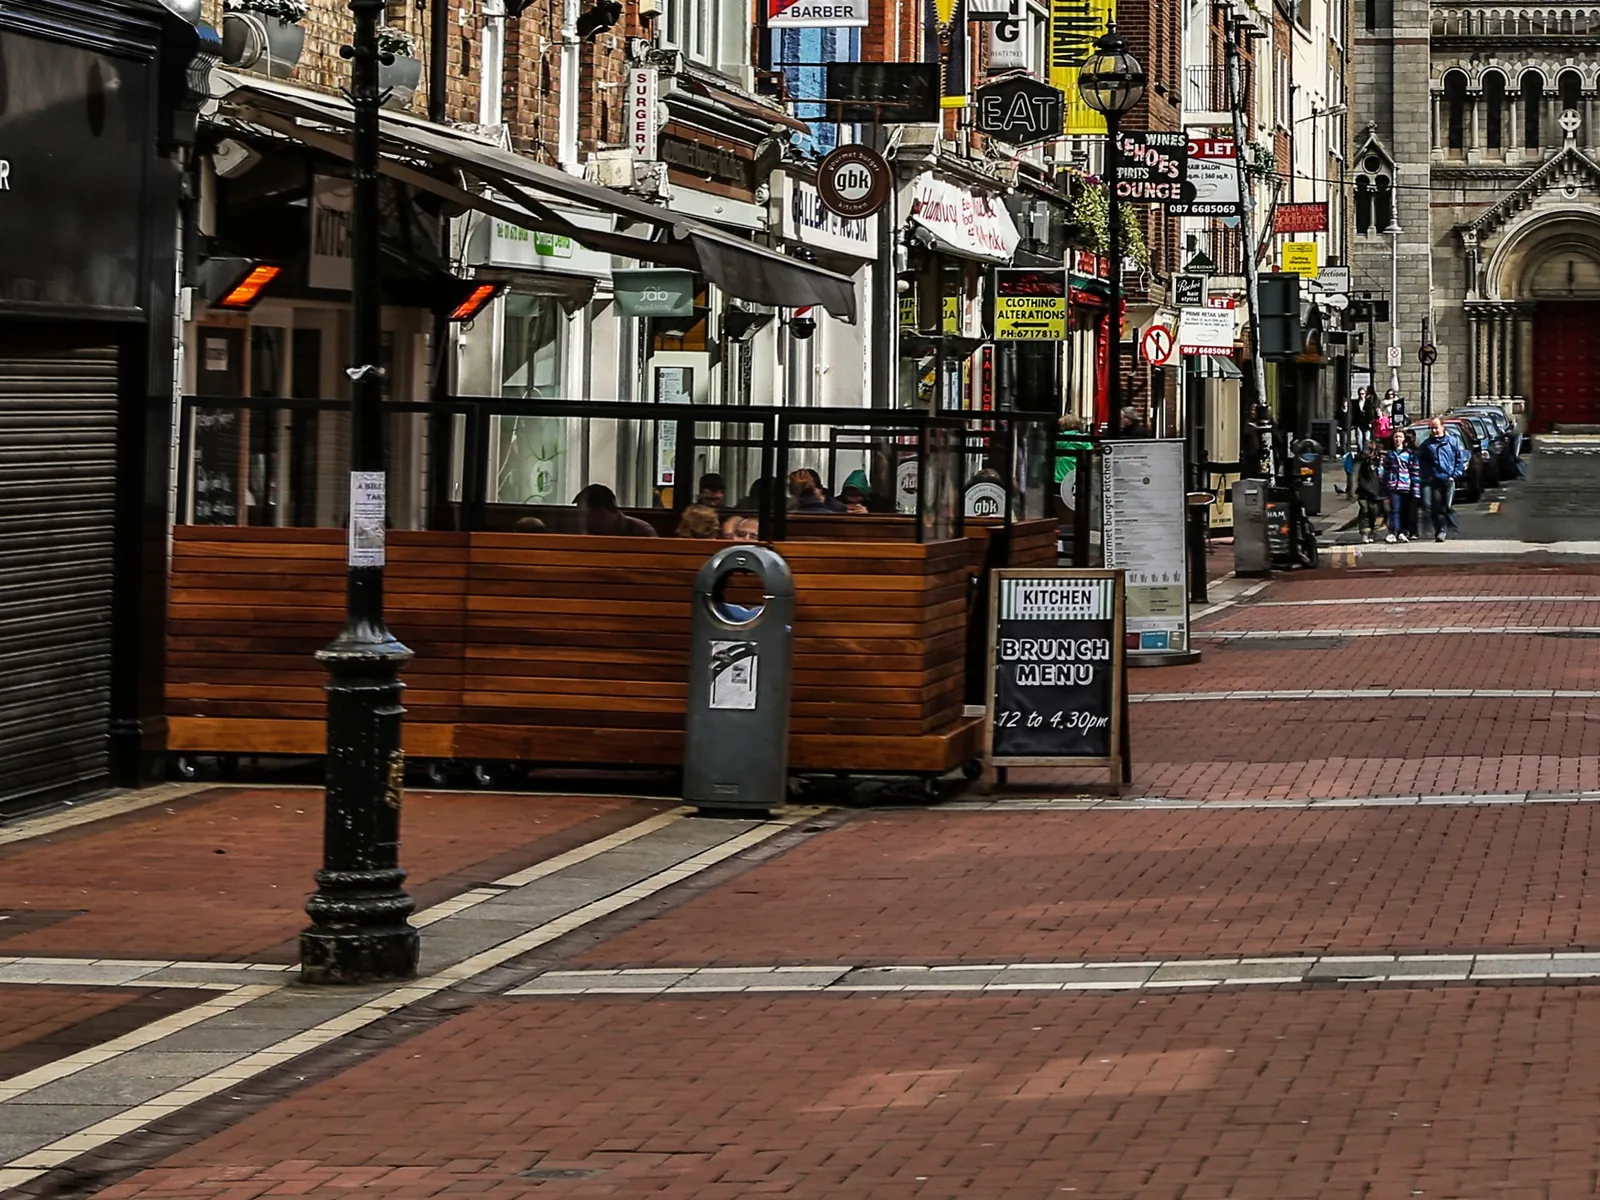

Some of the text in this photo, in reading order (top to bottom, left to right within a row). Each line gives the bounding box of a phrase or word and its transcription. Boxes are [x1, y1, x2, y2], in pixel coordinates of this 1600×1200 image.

[791, 6, 854, 18] BARBER
[636, 73, 647, 156] SURGERY
[983, 91, 1056, 132] EAT
[1145, 134, 1186, 147] WINES
[1187, 142, 1234, 155] O LET
[837, 170, 869, 191] gbk
[1116, 181, 1181, 200] OUNGE
[1169, 204, 1236, 214] 087 6685069
[1006, 299, 1057, 308] CLOTHING
[1207, 298, 1229, 308] LET
[997, 309, 1066, 320] ALTERATIONS
[1000, 329, 1060, 338] PH:6717813
[1198, 347, 1231, 355] 6685069
[975, 499, 998, 516] gbk
[1102, 457, 1115, 569] gourmet burger kitchen
[1023, 589, 1092, 605] KITCHEN
[1000, 638, 1110, 661] BRUNCH
[1016, 664, 1094, 686] MENU
[998, 710, 1109, 737] 12 to 4.30pm
